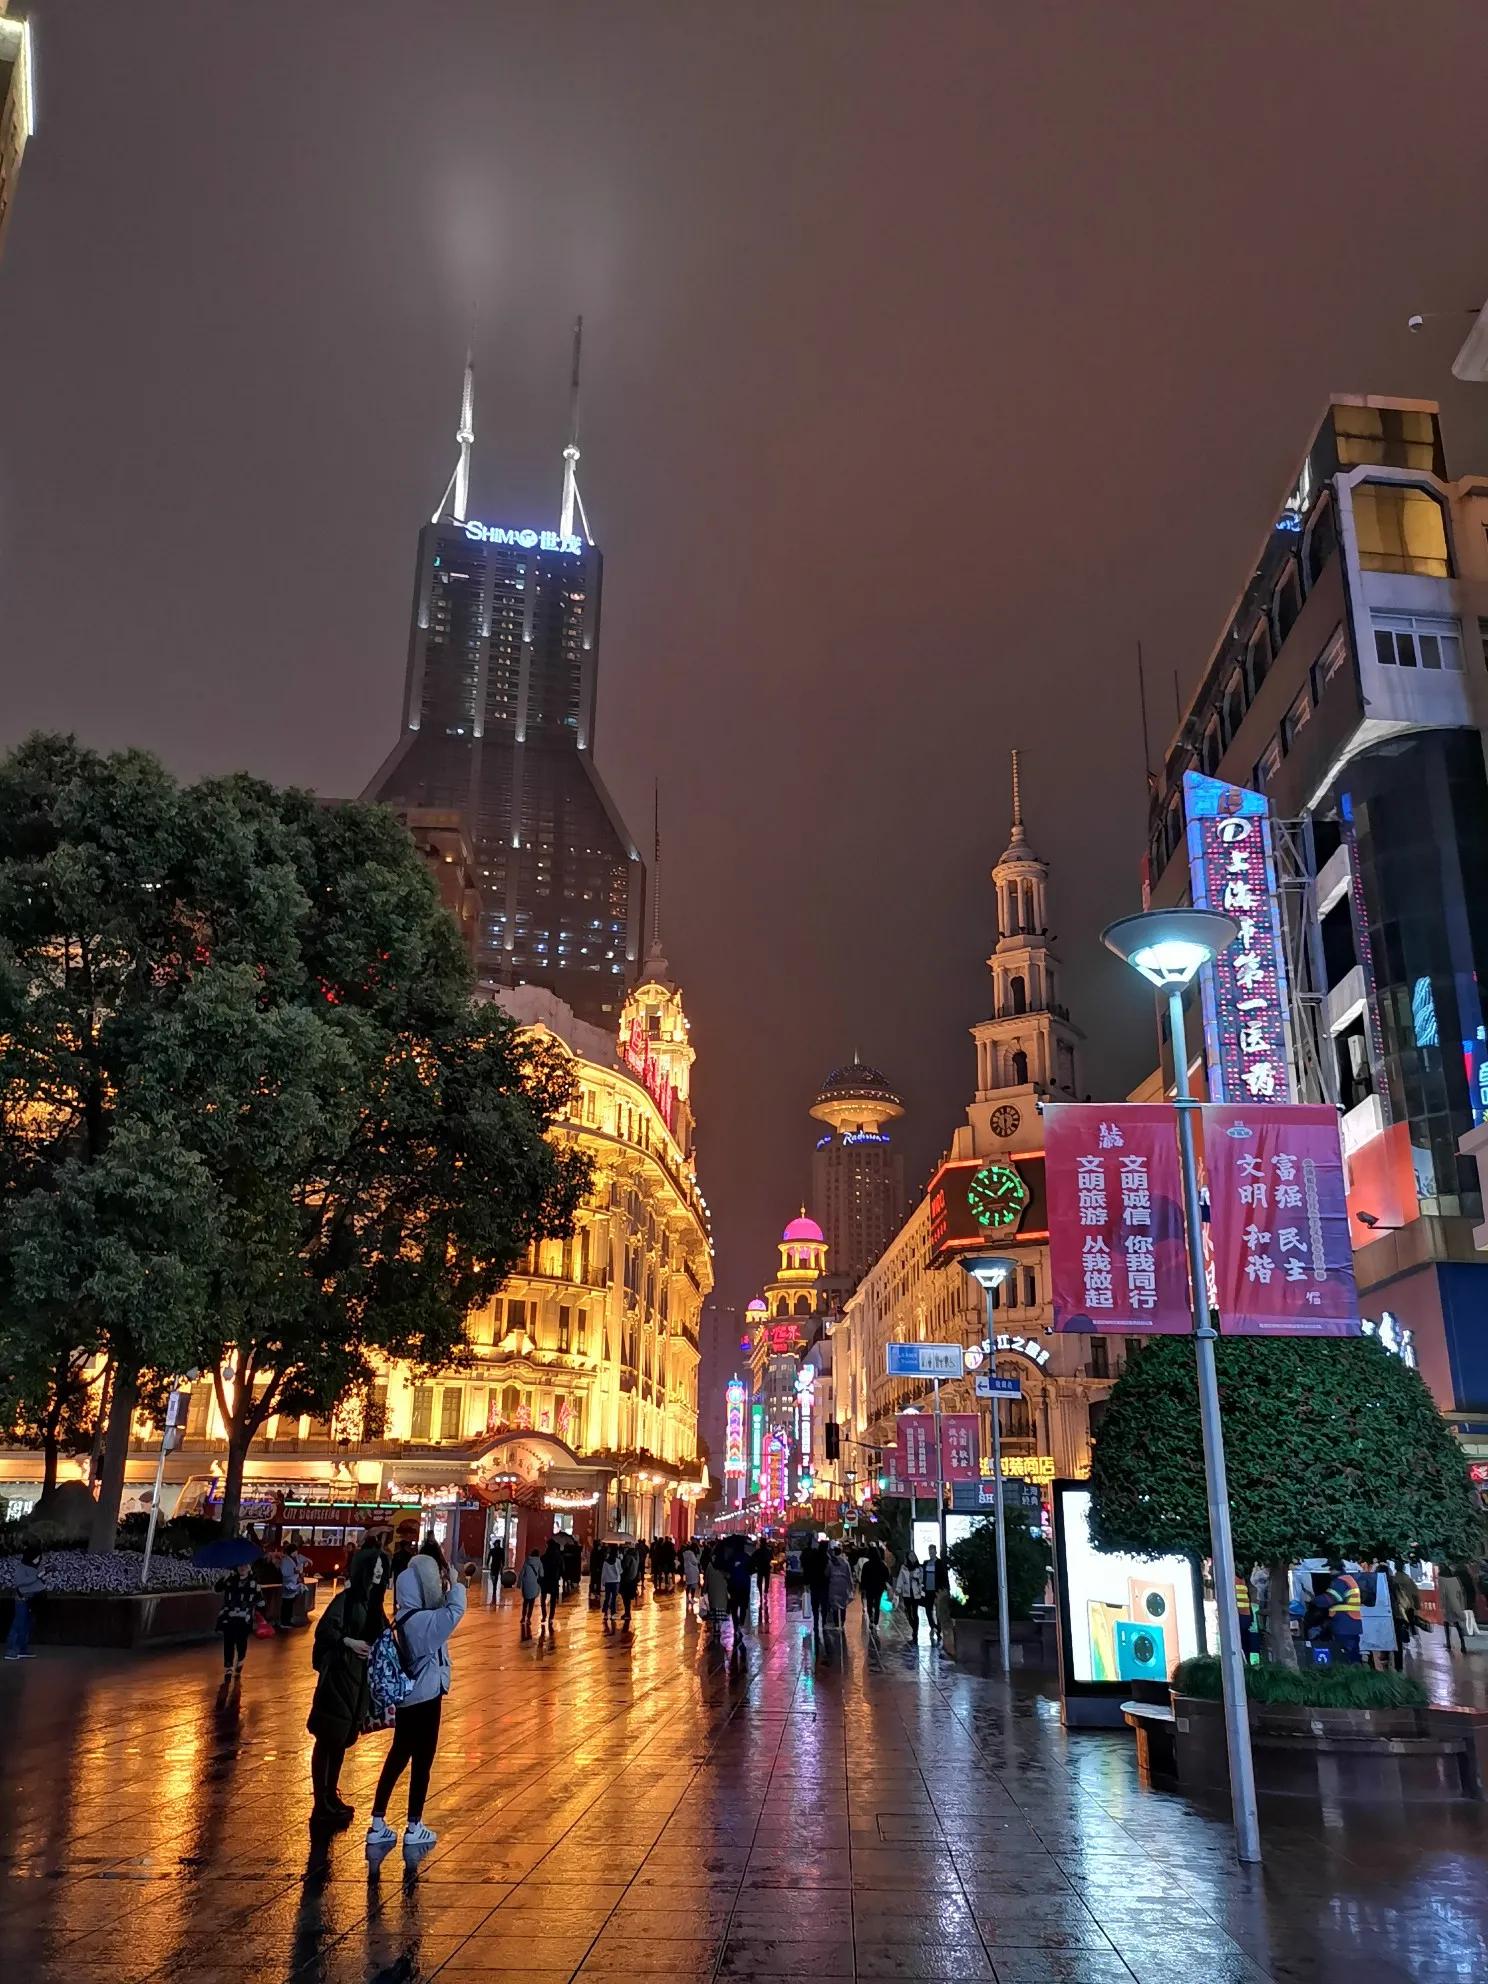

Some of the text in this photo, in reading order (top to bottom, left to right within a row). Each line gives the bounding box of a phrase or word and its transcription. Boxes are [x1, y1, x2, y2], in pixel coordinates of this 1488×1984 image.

[1076, 1154, 1114, 1309] 文明旅游 从我做起
[1119, 1154, 1158, 1309] 文明诚信 你我同行
[1236, 1153, 1268, 1209] 文明
[1270, 1153, 1309, 1283] 富强 民主
[1242, 1223, 1275, 1284] 和谐
